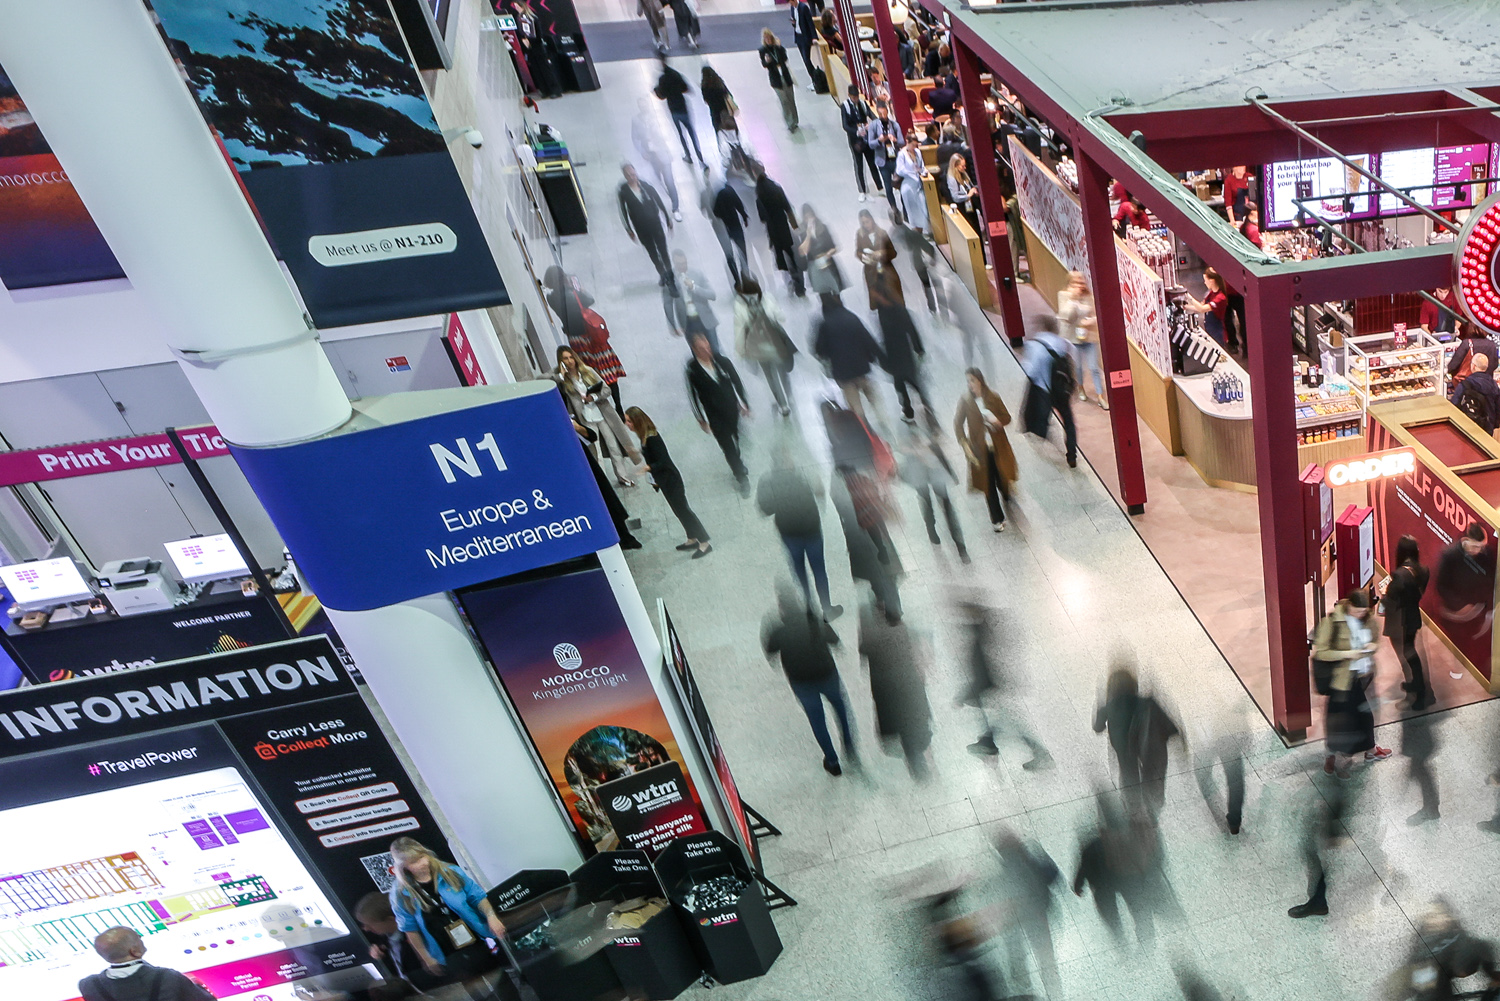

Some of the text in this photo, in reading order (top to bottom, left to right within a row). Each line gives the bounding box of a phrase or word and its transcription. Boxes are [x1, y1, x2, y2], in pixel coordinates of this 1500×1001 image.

[325, 233, 444, 258] Meet us @ N1-210
[38, 432, 228, 472] Print Your Tic
[429, 432, 508, 484] N1
[1329, 451, 1415, 486] ORDER
[439, 488, 553, 533] Europe &
[425, 514, 592, 569] Mediterranean
[173, 610, 252, 629] WELCOME PARTNER
[532, 672, 629, 700] Kingdom of light
[541, 665, 611, 688] MOROCCO
[0, 656, 339, 740] INFORMATION
[267, 718, 346, 741] Carry Less
[277, 729, 368, 754] Colleqt More
[88, 745, 198, 776] #TravelPower
[298, 781, 338, 793] information
[357, 772, 377, 783] place
[311, 772, 343, 784] collected
[343, 766, 372, 778] exhibitor
[370, 787, 388, 795] Code
[632, 779, 678, 803] wtm
[353, 810, 373, 819] visitor
[372, 806, 393, 816] badge
[383, 820, 414, 832] exhibitors
[626, 813, 694, 843] These lanyards
[635, 823, 692, 849] are plant silk
[684, 845, 721, 859] Take One
[686, 840, 713, 851] Please
[612, 864, 649, 873] Take One
[614, 858, 640, 866] Please
[498, 883, 523, 902] Please
[498, 886, 531, 912] Take One
[711, 911, 737, 924] wtm
[614, 936, 640, 944] wtm
[327, 951, 346, 960] Official
[279, 962, 298, 971] Official
[233, 973, 253, 982] Official
[239, 981, 260, 990] Partner
[245, 976, 262, 985] Media
